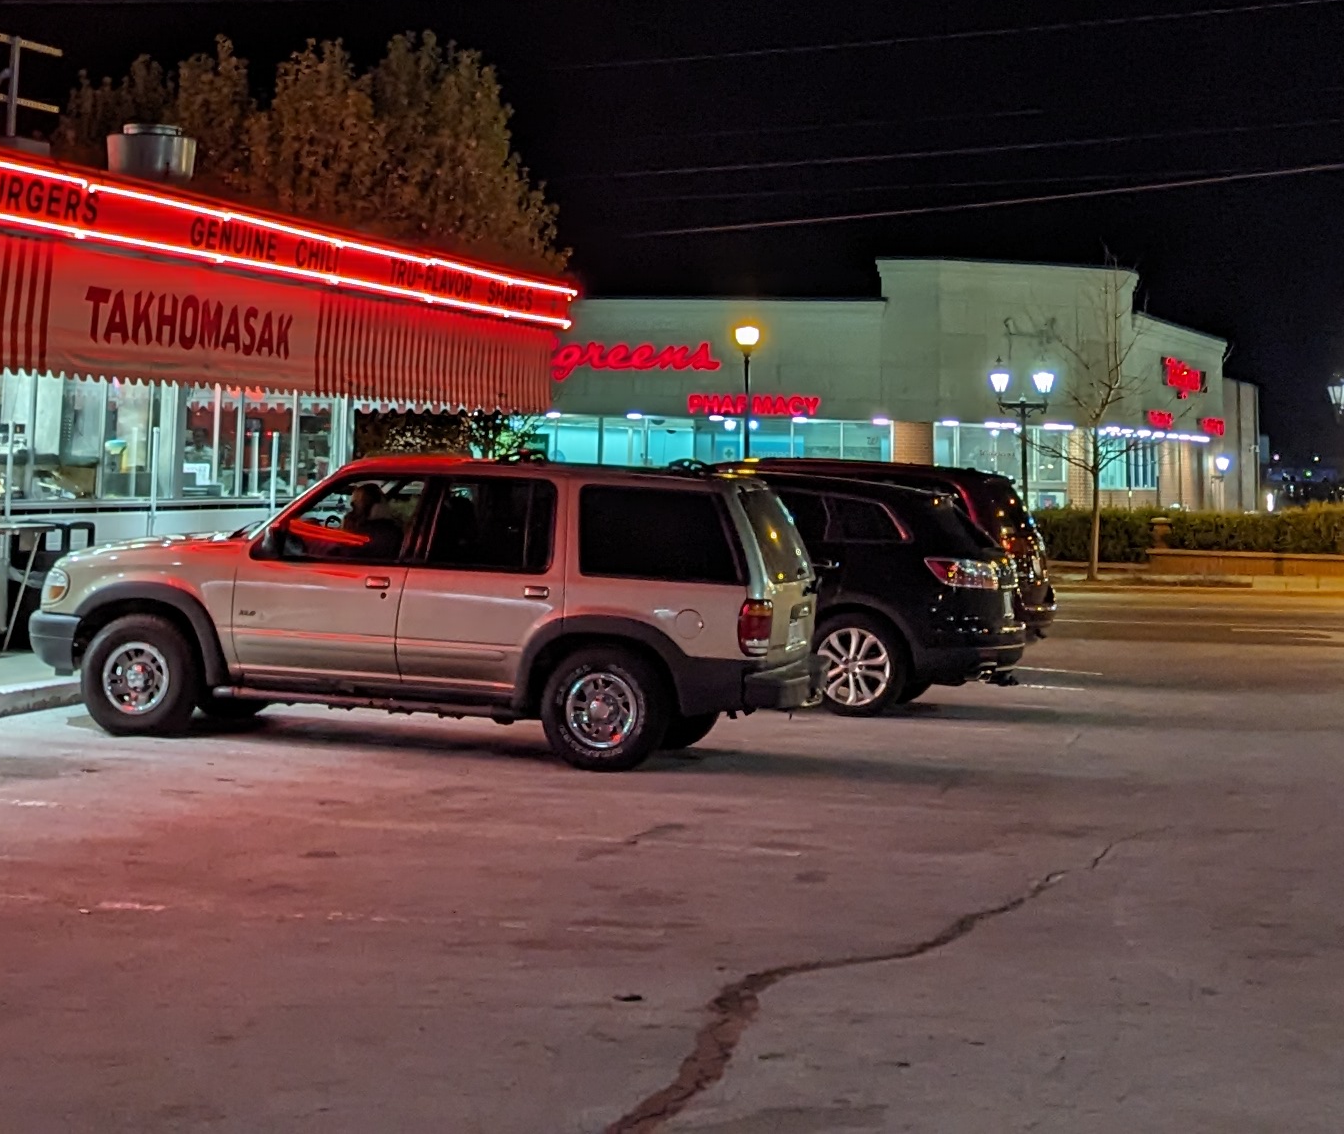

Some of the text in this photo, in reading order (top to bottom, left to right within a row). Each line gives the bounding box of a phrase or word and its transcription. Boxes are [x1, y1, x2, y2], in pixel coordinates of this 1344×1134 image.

[190, 216, 340, 273] GENUINE CHILI
[390, 258, 533, 311] TRU-FLAVOR SHAKES
[85, 285, 293, 360] TAKHOMASAK
[551, 341, 720, 382] greens
